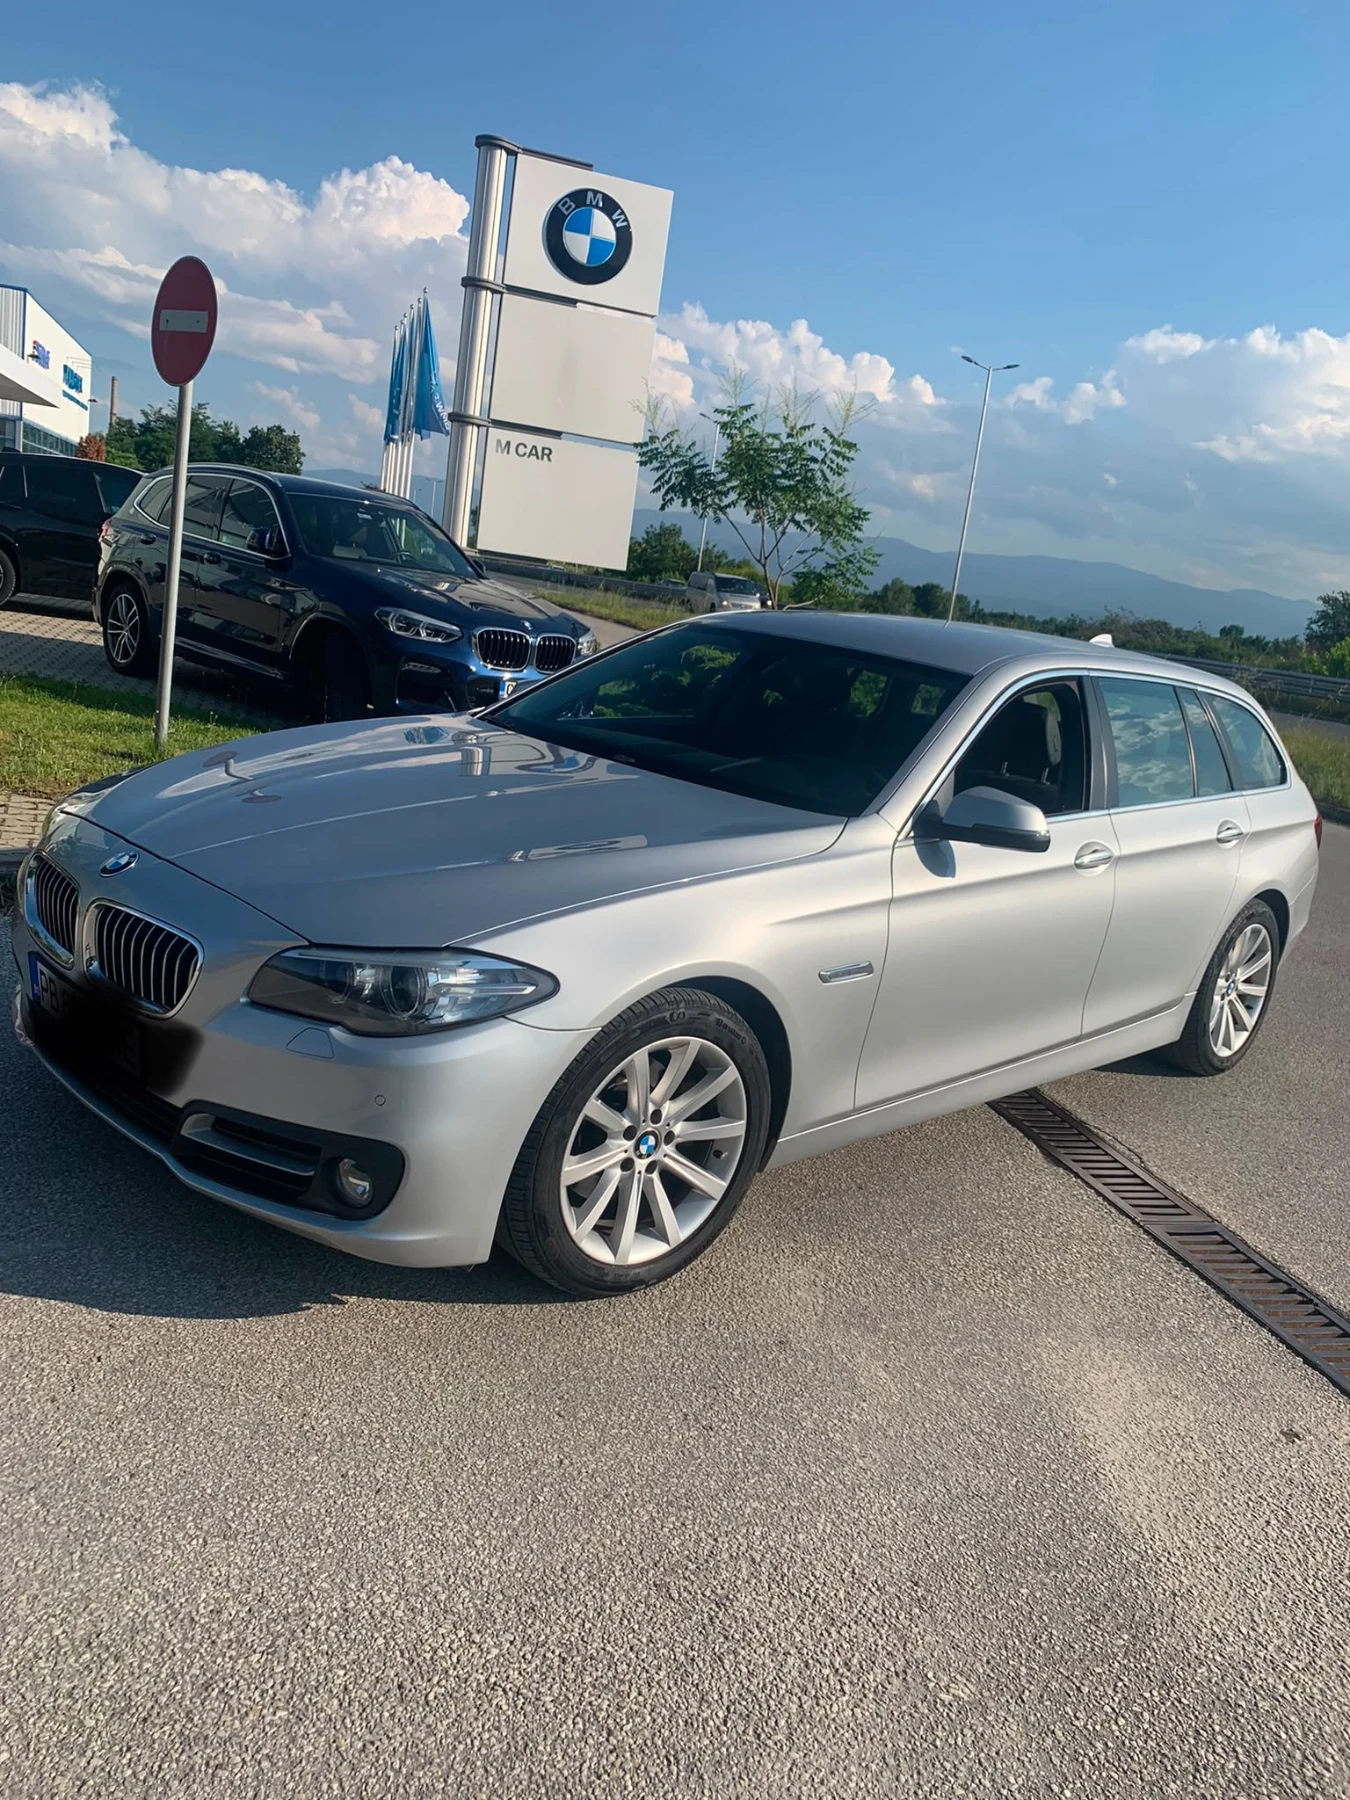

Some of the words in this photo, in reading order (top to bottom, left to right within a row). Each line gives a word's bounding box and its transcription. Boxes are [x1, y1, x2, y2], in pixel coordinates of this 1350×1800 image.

[557, 190, 628, 228] BMW
[495, 438, 511, 455] M
[515, 442, 553, 463] CAR
